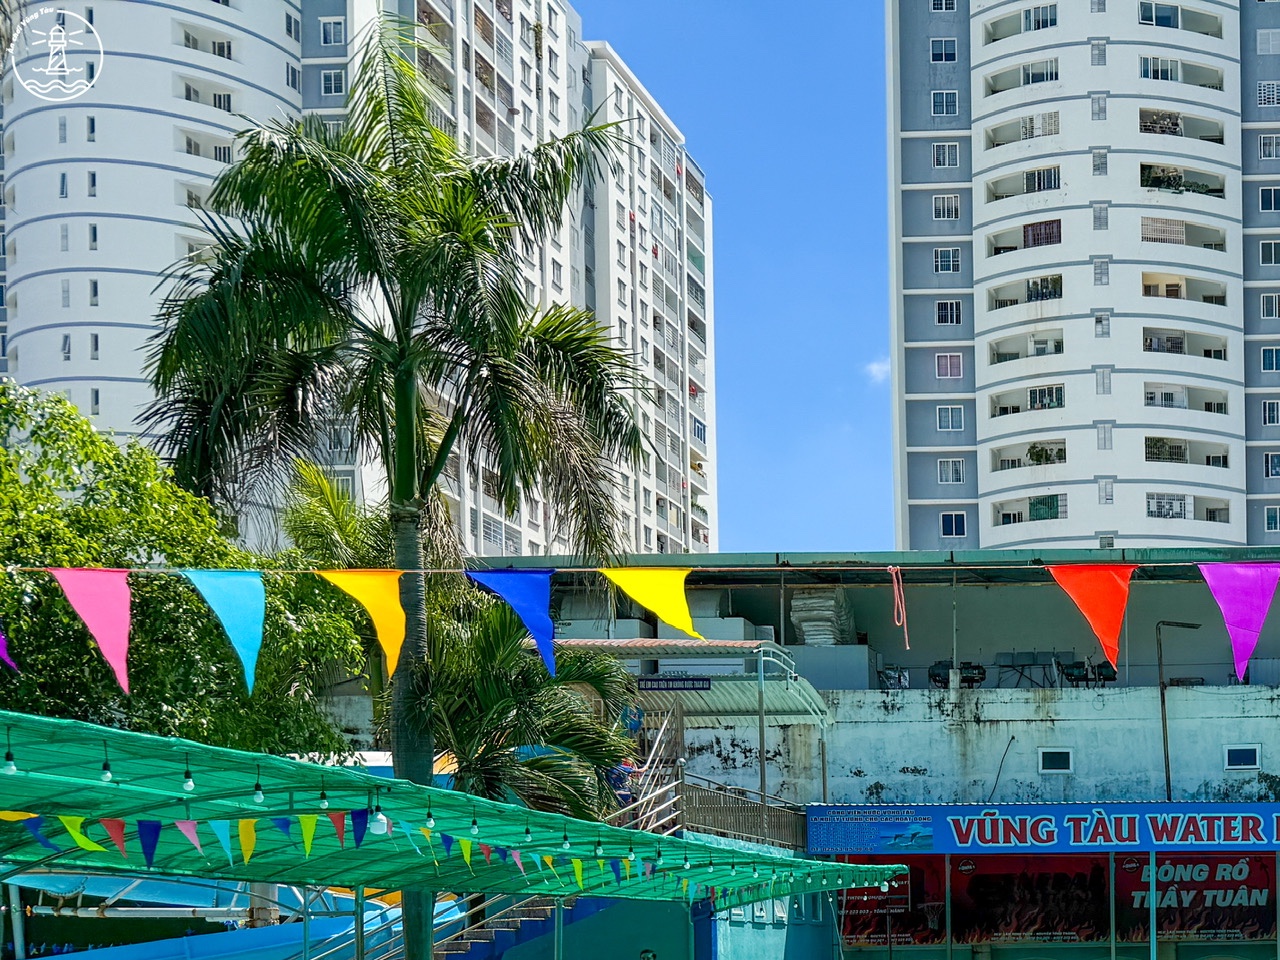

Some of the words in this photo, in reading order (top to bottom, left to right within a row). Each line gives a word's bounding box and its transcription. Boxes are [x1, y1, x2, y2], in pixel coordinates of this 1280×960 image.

[948, 810, 1058, 847] VŨNG
[1064, 808, 1142, 846] TÀU
[1146, 813, 1267, 845] WATER
[1140, 860, 1210, 882] BÓNG
